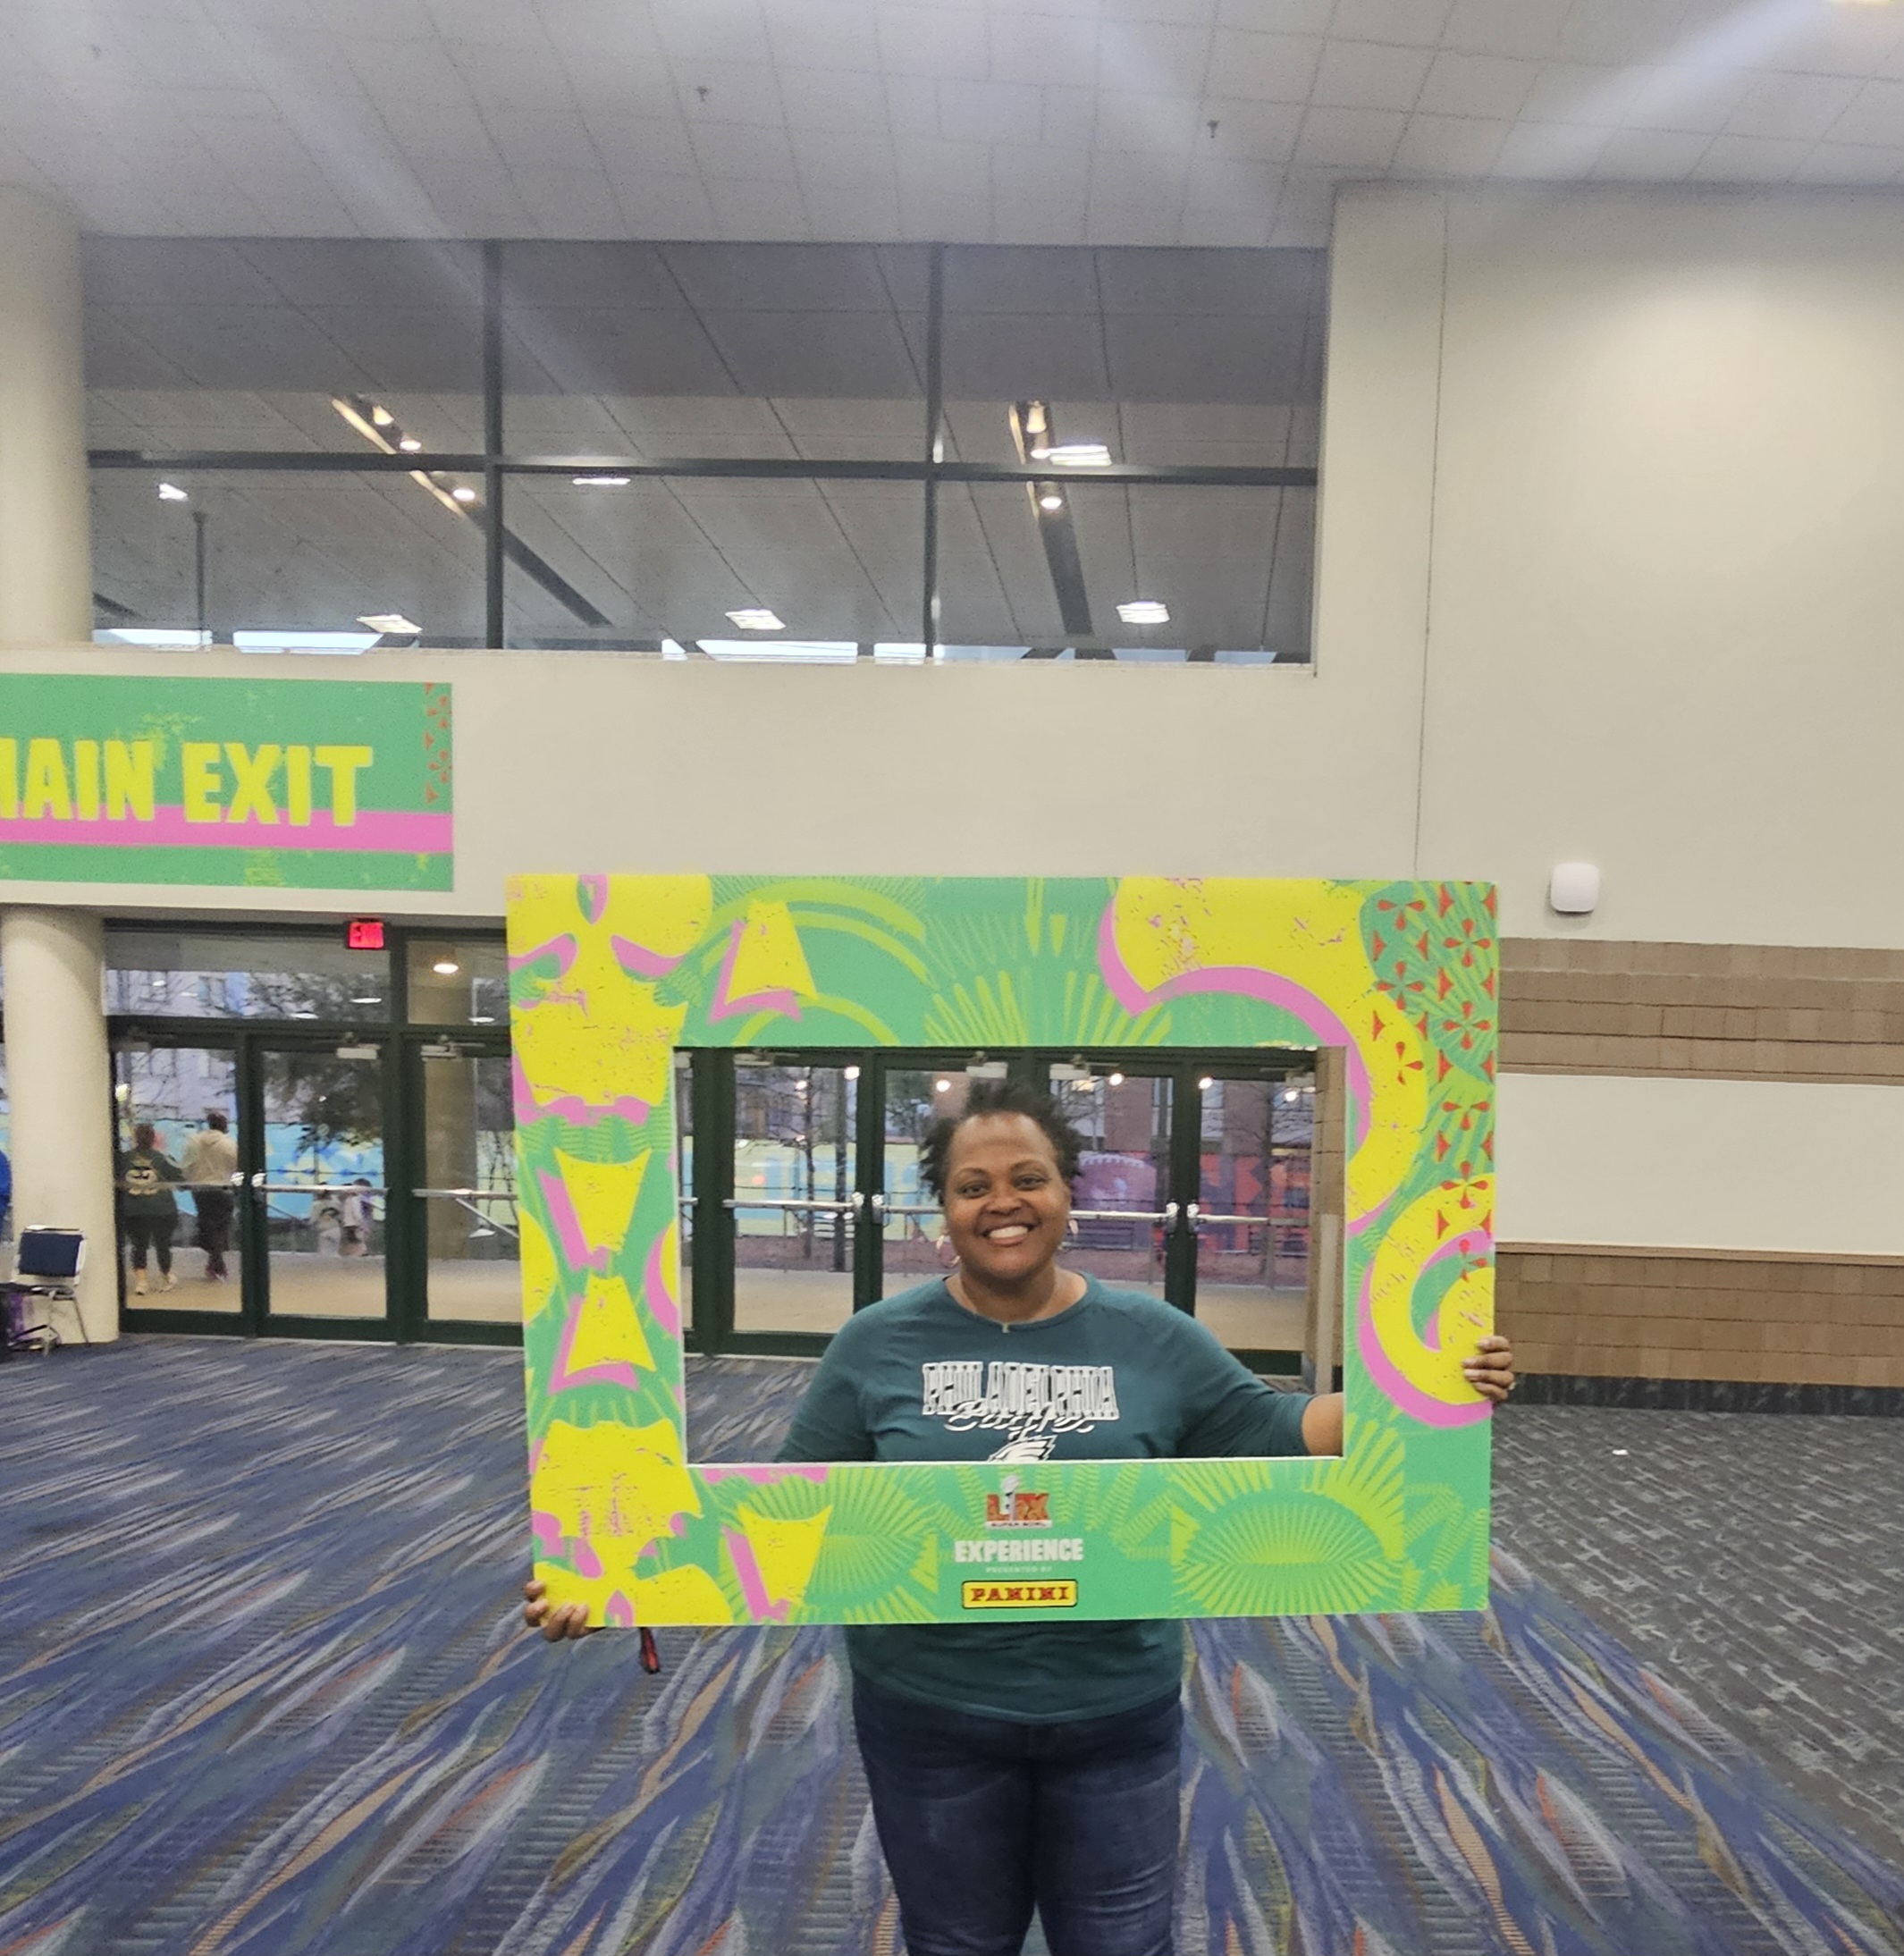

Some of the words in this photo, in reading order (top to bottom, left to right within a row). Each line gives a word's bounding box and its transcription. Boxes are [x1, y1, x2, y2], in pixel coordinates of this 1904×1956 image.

[181, 741, 374, 827] EXIT
[954, 1539, 1083, 1564] EXPERIENCE
[970, 1586, 1070, 1602] PANINI
